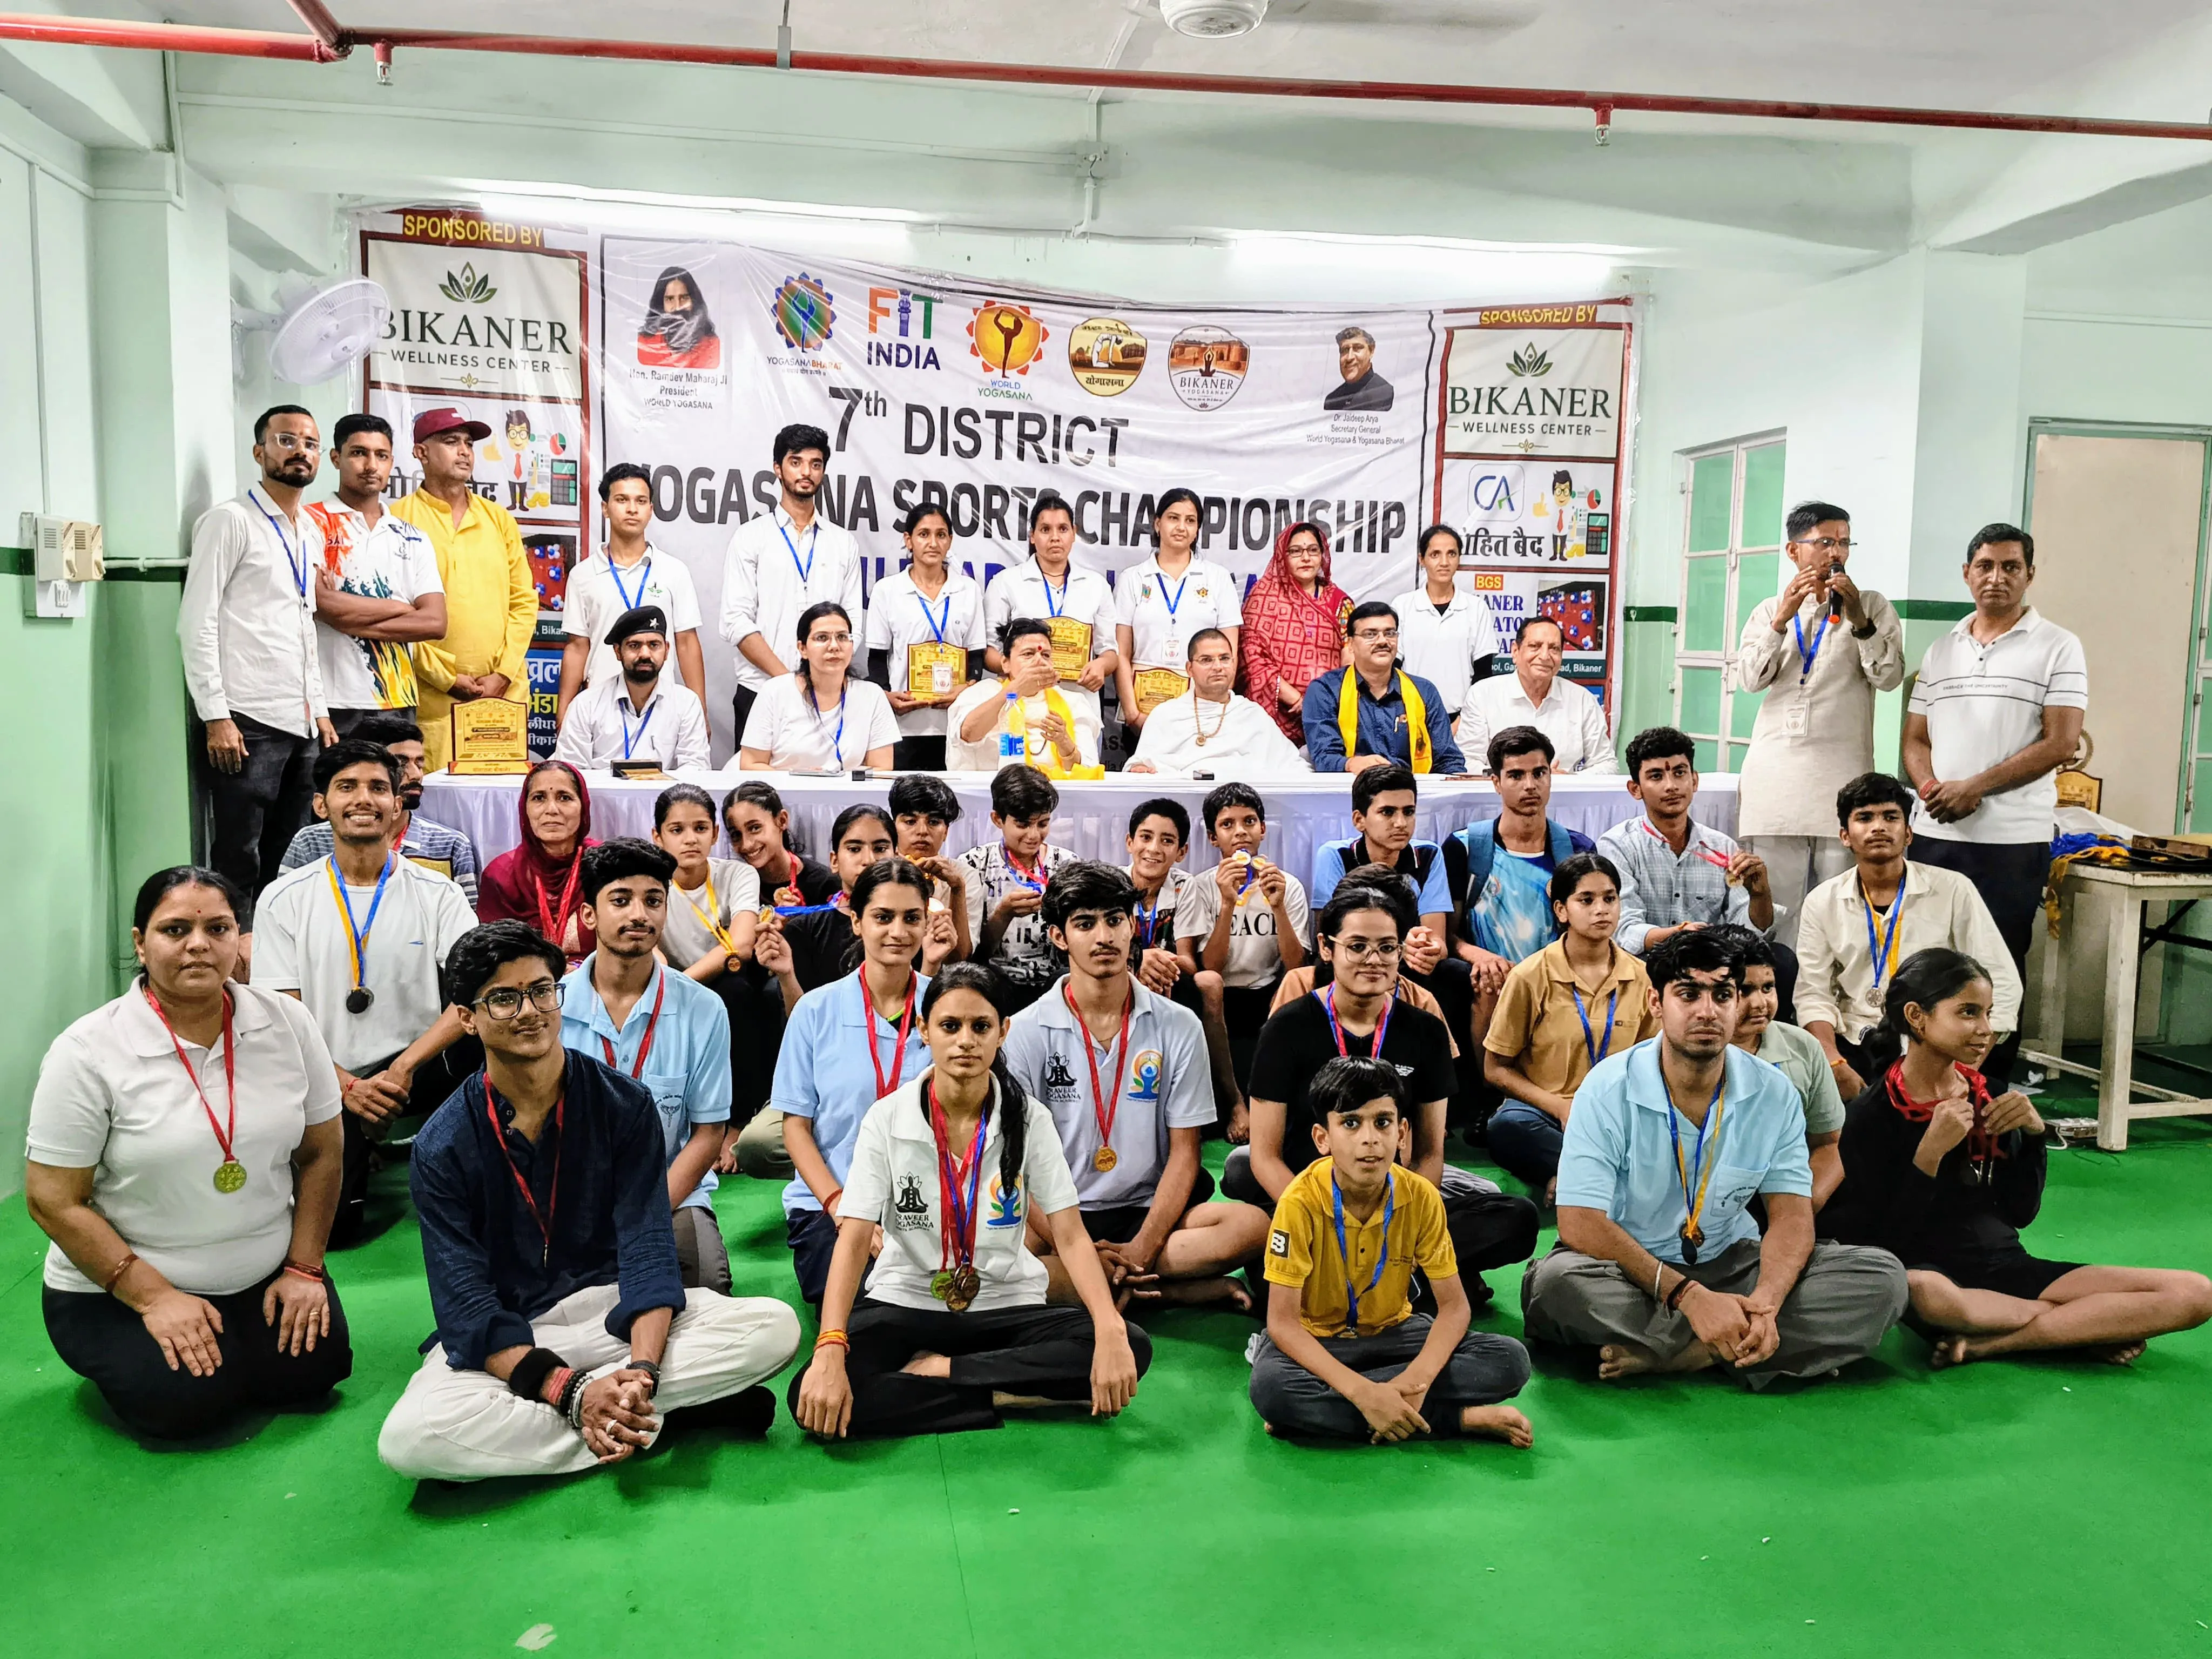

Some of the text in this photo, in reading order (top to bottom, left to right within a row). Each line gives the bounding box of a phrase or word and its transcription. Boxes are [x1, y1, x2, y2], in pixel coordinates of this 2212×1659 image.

[403, 214, 544, 247] SPONSORED BY
[868, 286, 943, 340] FIT
[1481, 305, 1596, 324] SPONSORED BY
[391, 349, 550, 373] WELLNESS CENTER
[867, 341, 941, 371] INDIA
[651, 370, 683, 383] Ramdev
[685, 373, 718, 386] Maharaj
[990, 379, 1021, 390] WORLD
[1085, 375, 1124, 387] योगासना
[1179, 376, 1234, 390] BIKANER
[660, 385, 698, 396] President
[977, 387, 1033, 401] YOGASANA
[644, 398, 713, 409] WORLD YOGASANA
[1448, 386, 1612, 419] BIKANER
[1343, 414, 1365, 424] Jaideep
[1365, 414, 1379, 424] Arya
[828, 386, 1129, 468] 7th DISTRICT
[1331, 424, 1381, 435] Secretary General
[1462, 421, 1592, 436] WELLNESS CENTER
[1306, 434, 1323, 443] World
[1323, 435, 1351, 445] Yogasana
[1352, 436, 1357, 444] &
[1357, 436, 1385, 446] Yogasana
[1473, 475, 1515, 512] CA
[641, 463, 879, 532] OGASNA
[1075, 489, 1405, 554] CHAPIONSHIP
[1513, 526, 1545, 557] बैद
[1475, 576, 1502, 589] BGS
[1573, 663, 1603, 673] Bikaner
